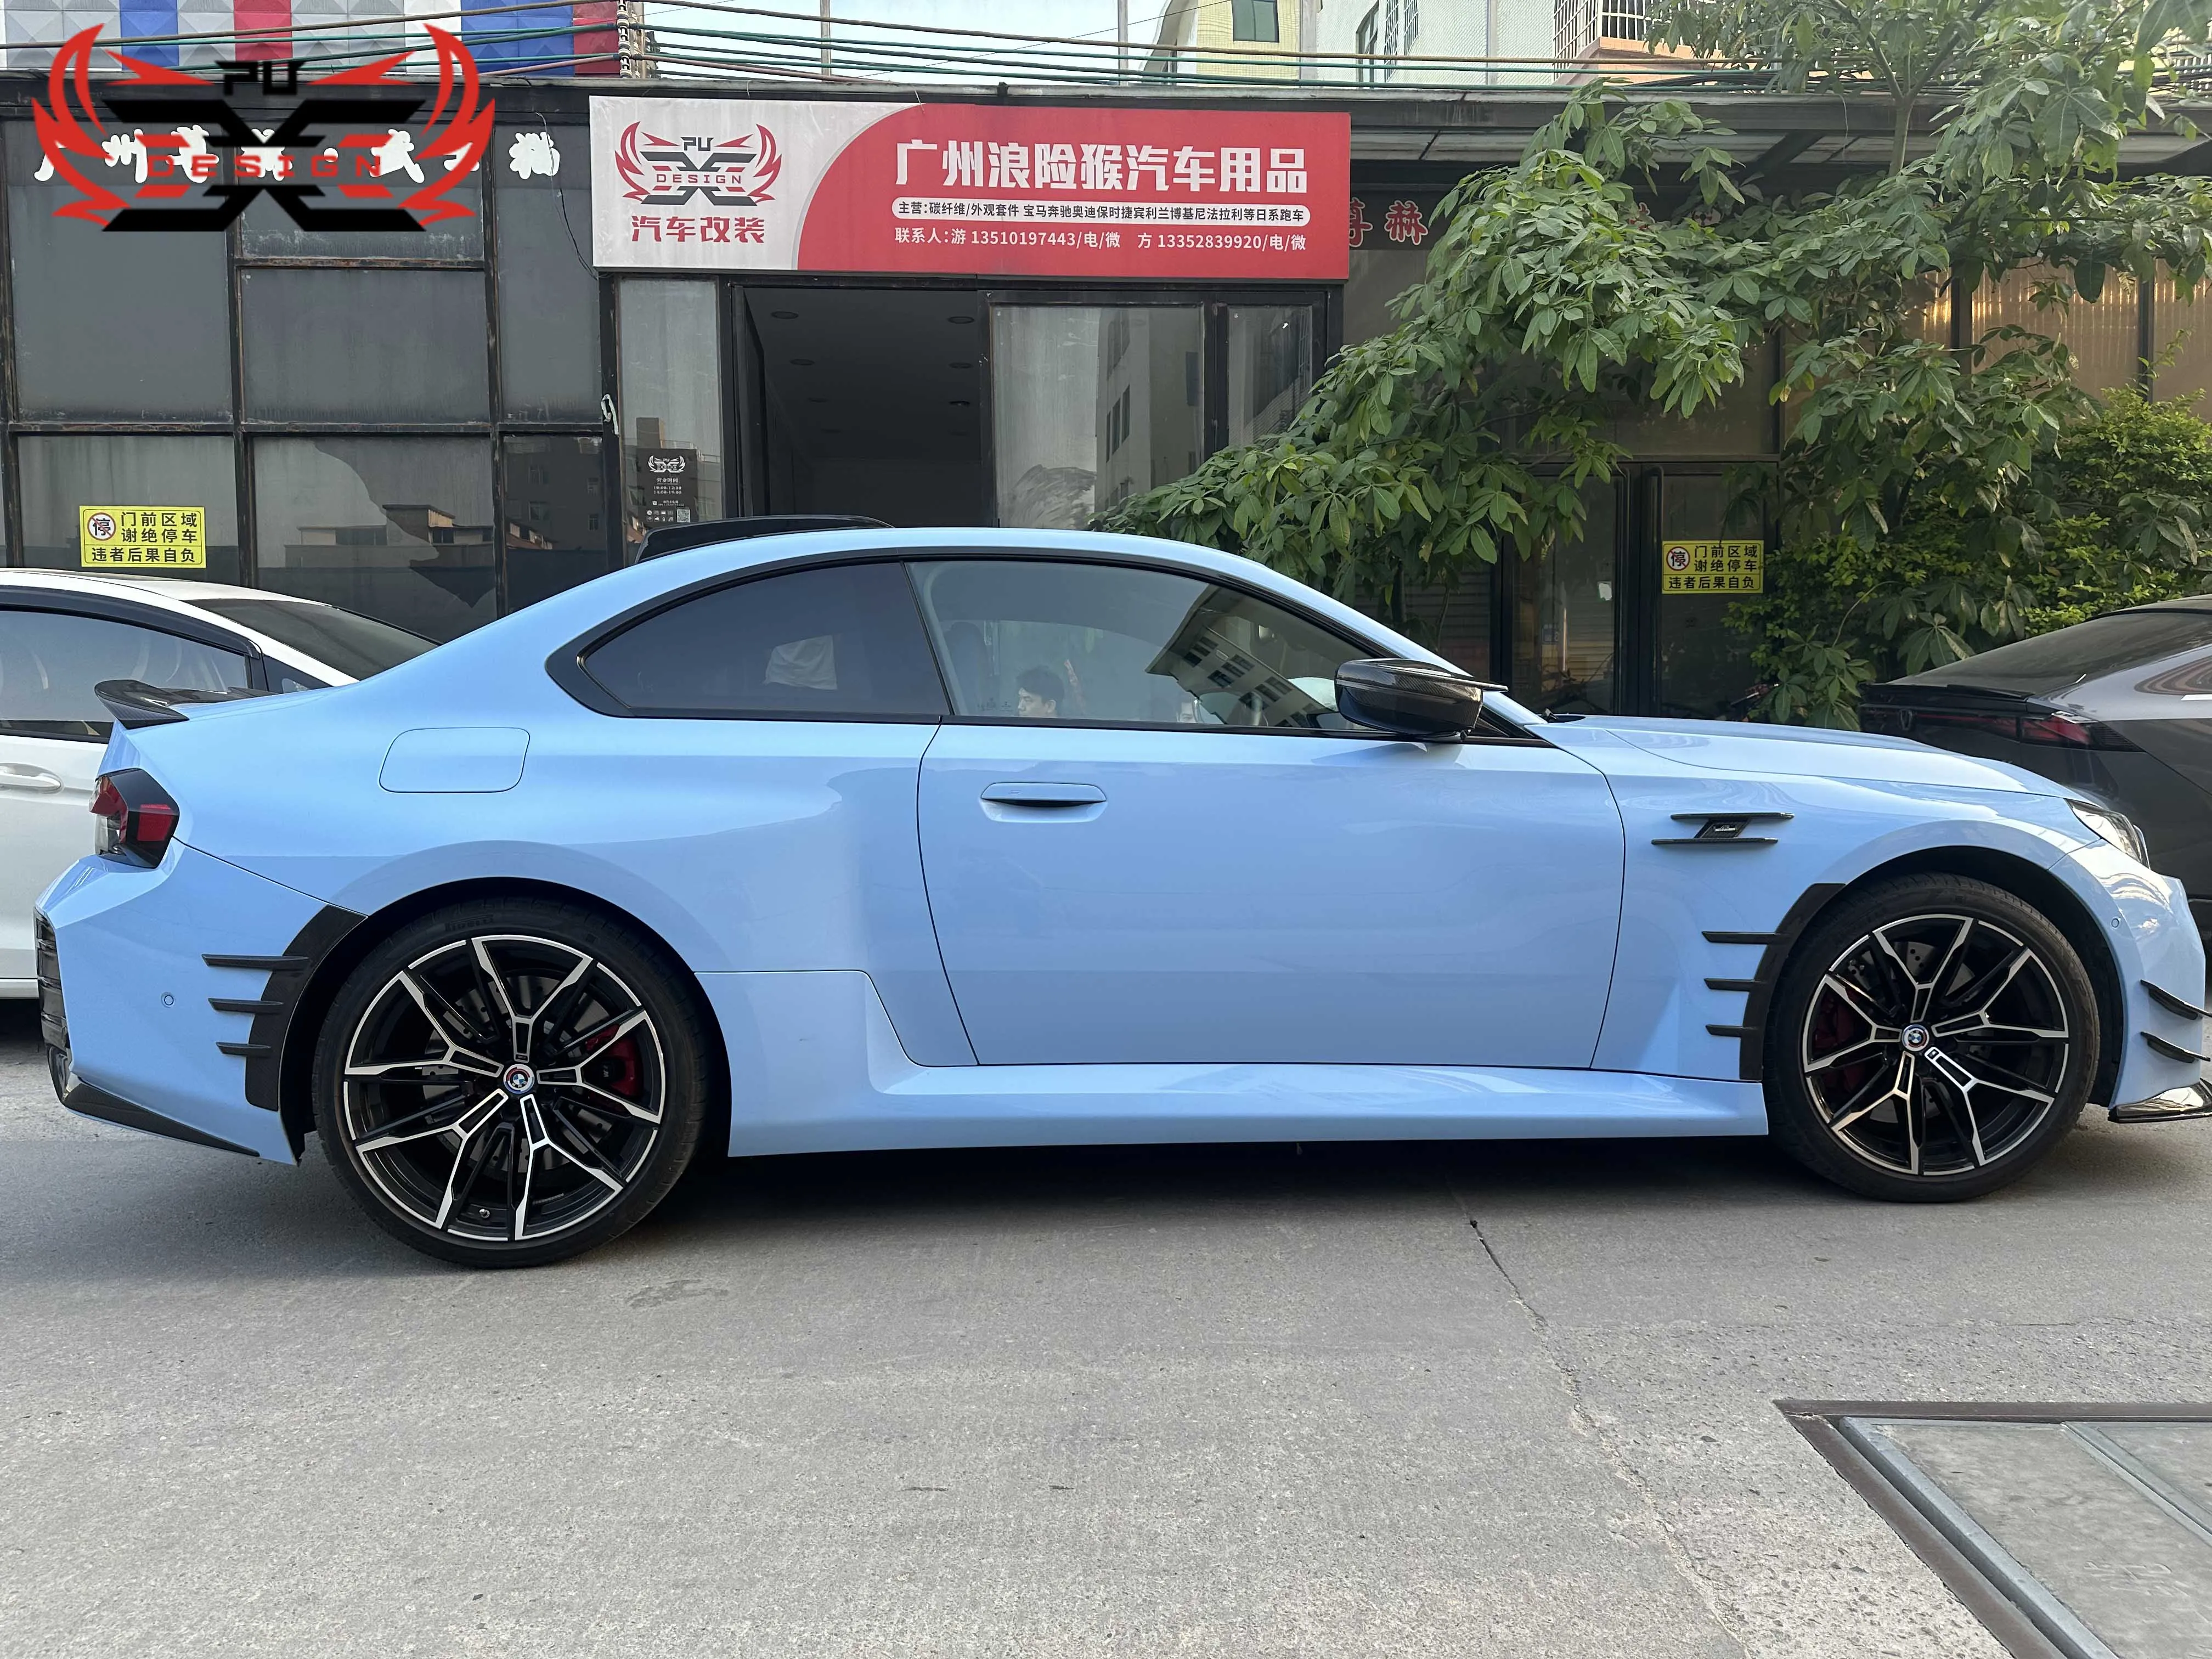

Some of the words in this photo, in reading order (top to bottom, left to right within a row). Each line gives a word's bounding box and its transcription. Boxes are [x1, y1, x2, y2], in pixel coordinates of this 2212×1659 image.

[680, 137, 714, 151] PU
[895, 139, 1307, 193] 广州浪险猴汽车用品
[656, 174, 742, 184] DESIGN
[1023, 204, 1304, 222] 宝马奔驰奥迪保时捷宾利兰博基尼法拉利等日系跑车
[631, 216, 765, 243] 汽车改装
[971, 230, 1120, 250] 13510197443/电/微
[1137, 232, 1152, 249] 方
[1158, 234, 1306, 252] 13352839920/电/微
[121, 511, 198, 527] 门前区域
[121, 528, 198, 543] 谢绝停车
[92, 547, 195, 562] 违者后果自负
[1694, 545, 1757, 558] 门前区域
[1694, 559, 1757, 572] 谢绝停车
[1668, 576, 1754, 589] 违者后果自负
